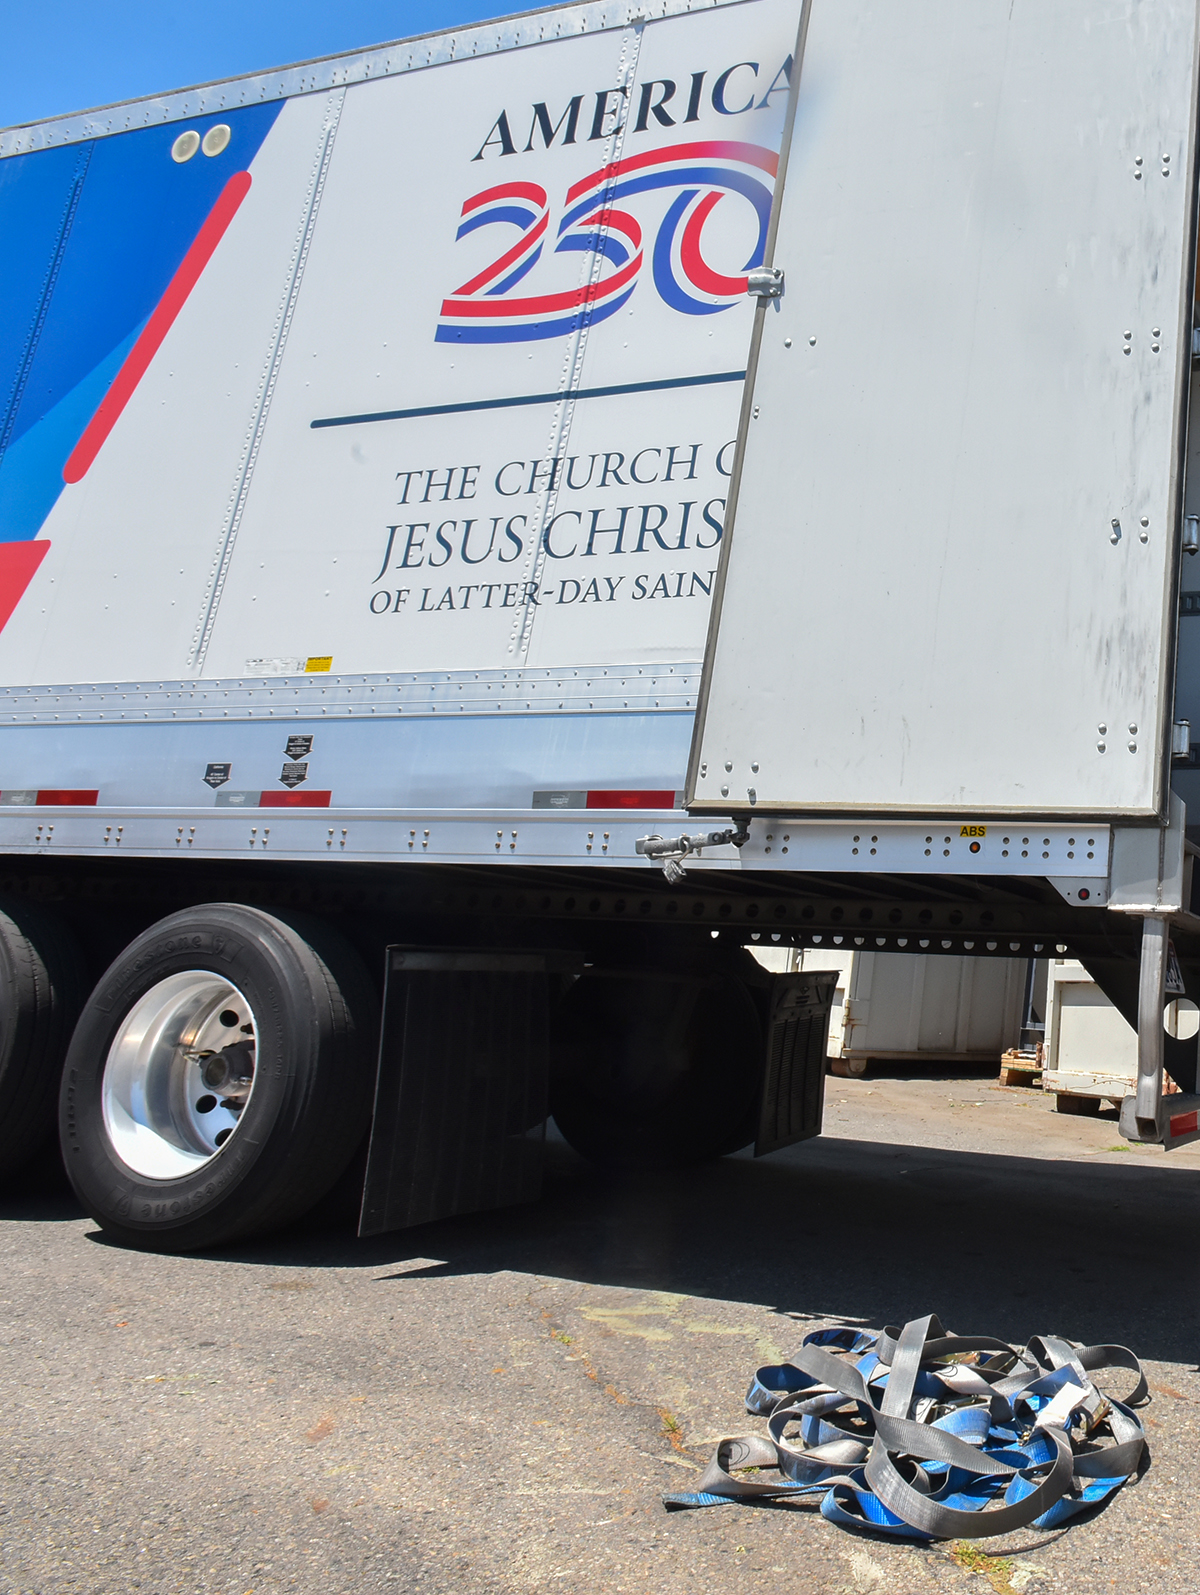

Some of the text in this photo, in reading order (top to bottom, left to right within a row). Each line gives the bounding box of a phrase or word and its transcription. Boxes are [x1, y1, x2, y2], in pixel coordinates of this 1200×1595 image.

[470, 53, 794, 162] AMERICA
[434, 140, 780, 344] 250
[395, 463, 481, 506] THE
[495, 442, 705, 497] CHURCH
[374, 513, 528, 584] JESUS
[369, 589, 410, 615] OF
[417, 573, 626, 612] LATTER-DAY
[960, 826, 986, 837] ABS
